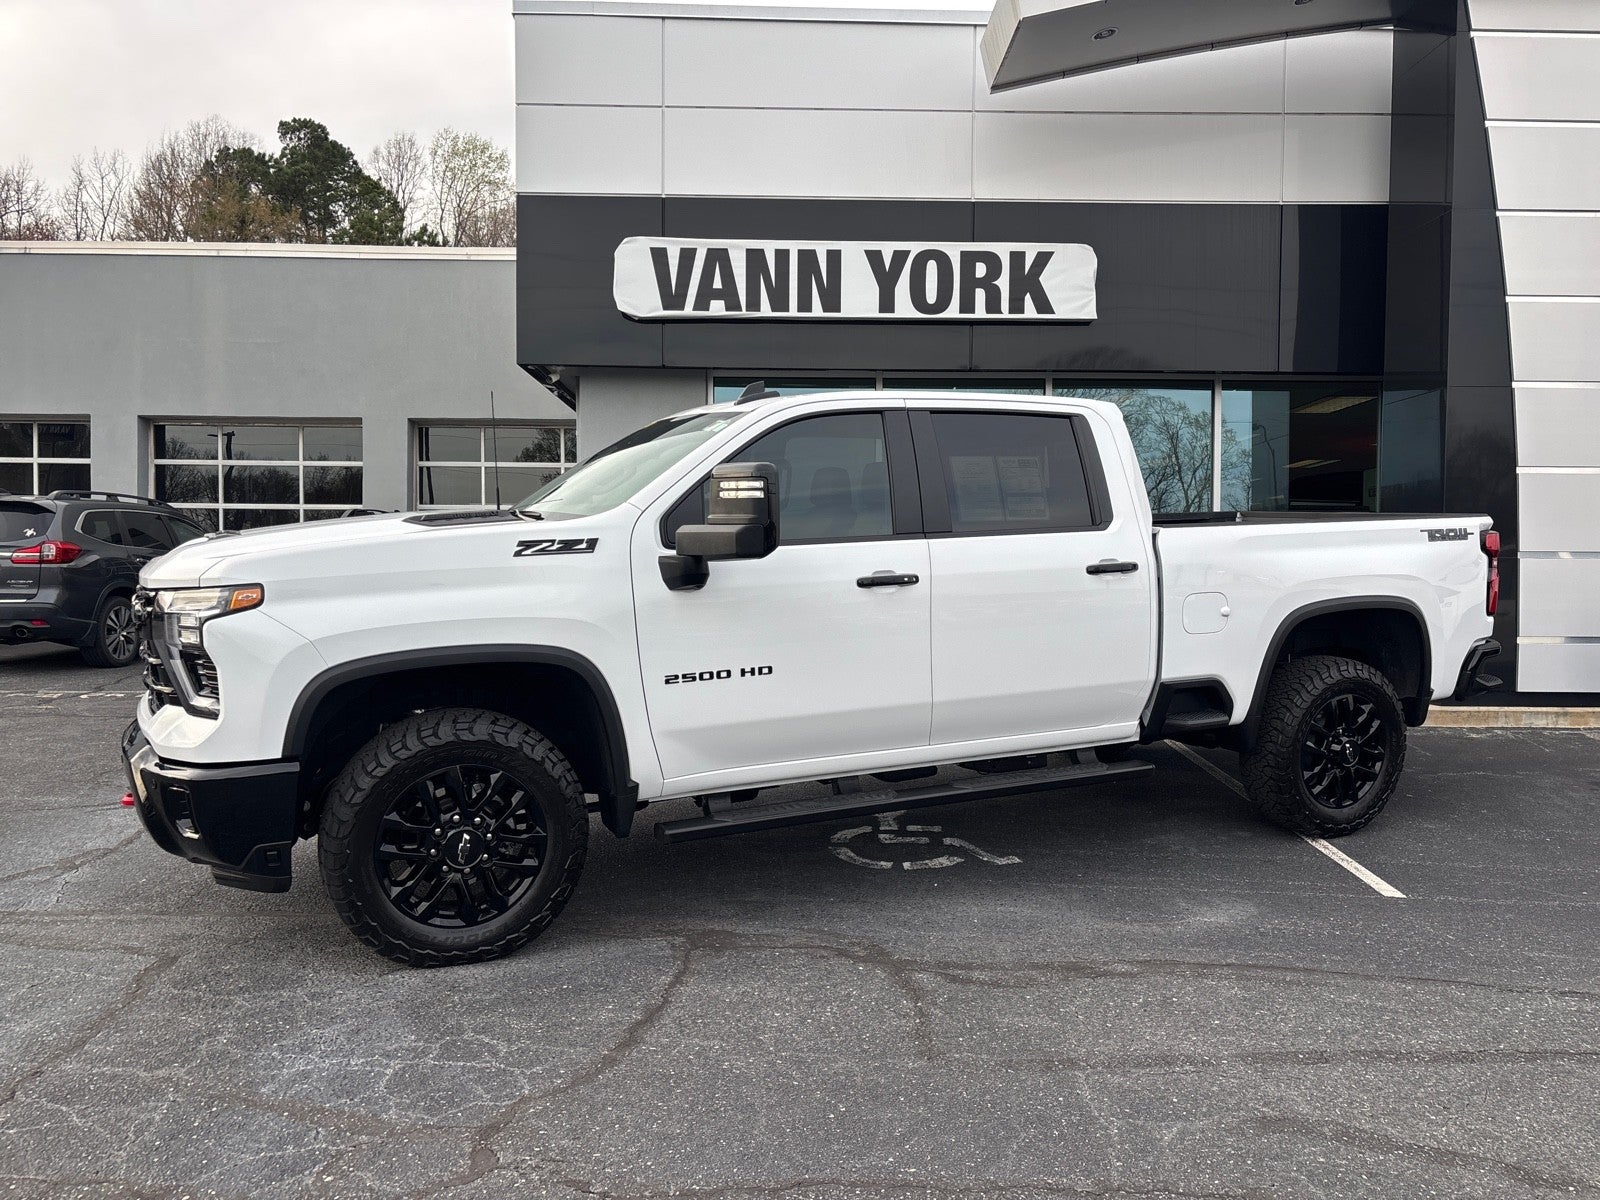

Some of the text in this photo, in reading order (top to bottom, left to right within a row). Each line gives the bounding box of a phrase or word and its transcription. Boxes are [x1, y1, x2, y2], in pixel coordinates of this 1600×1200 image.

[649, 246, 1056, 315] VANN YORK
[664, 665, 773, 685] 2500 HD
